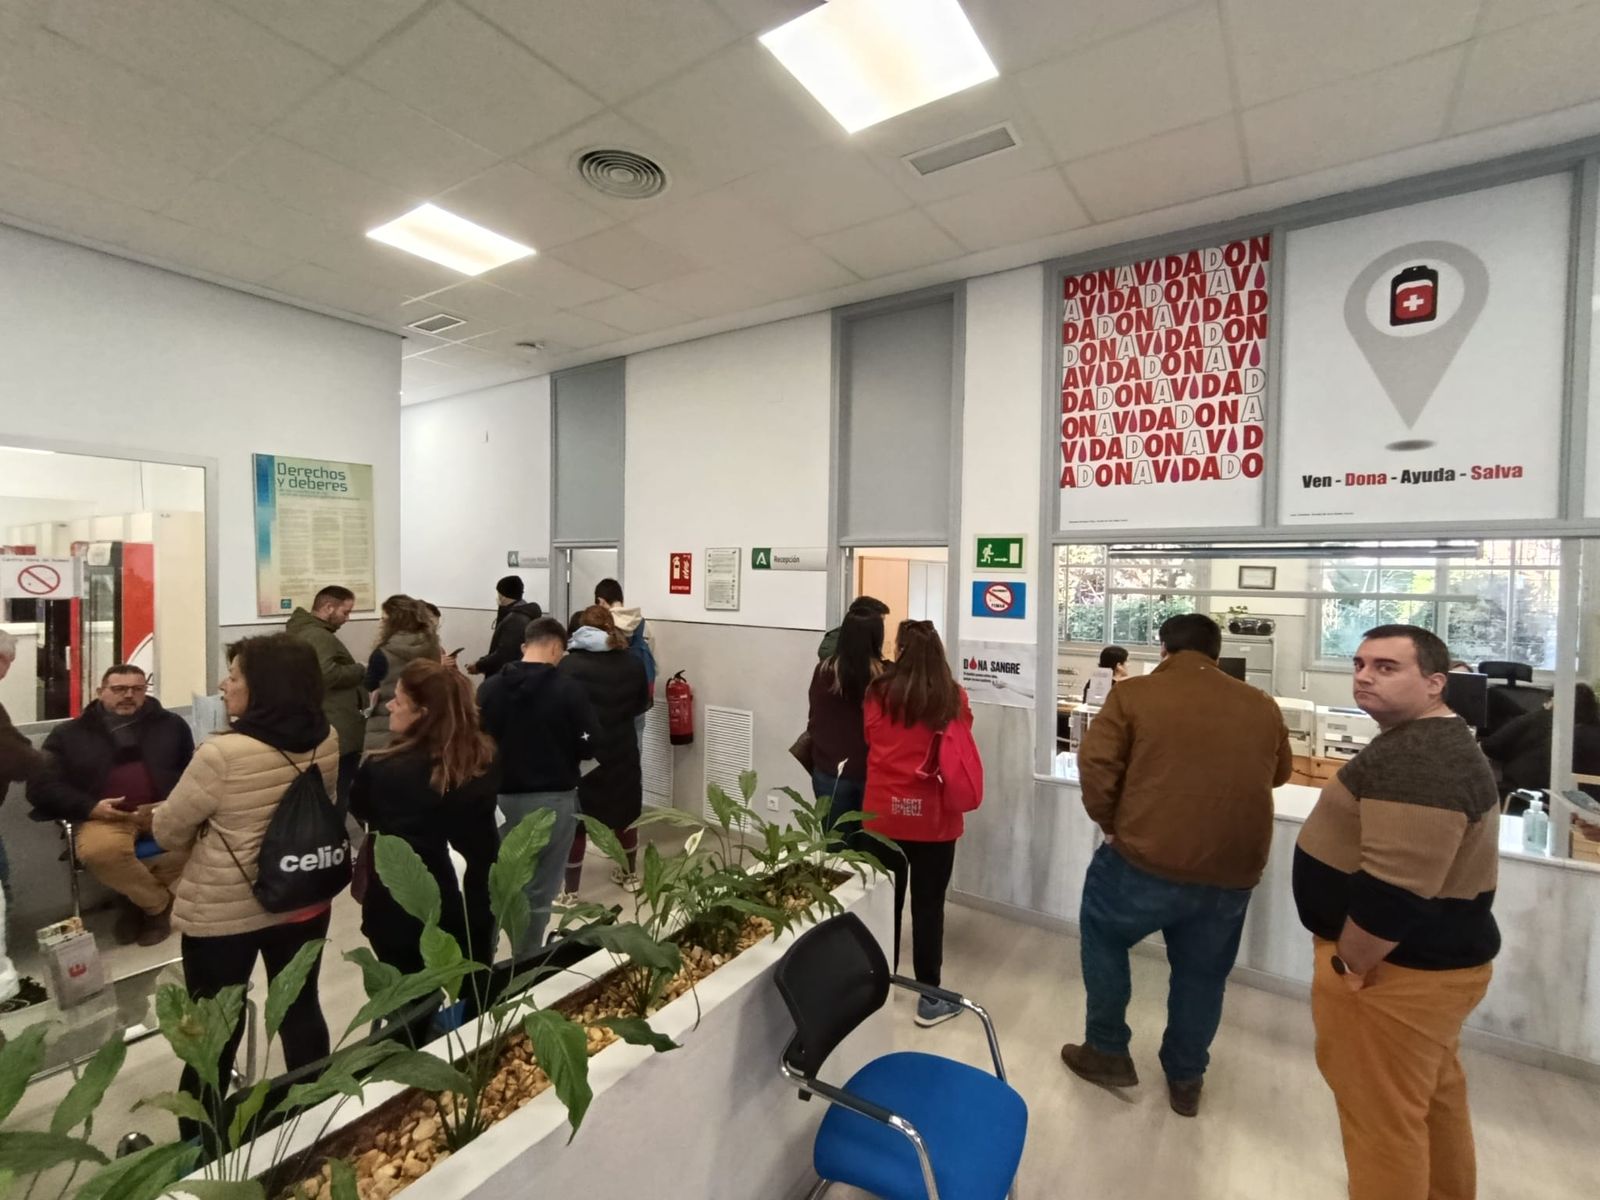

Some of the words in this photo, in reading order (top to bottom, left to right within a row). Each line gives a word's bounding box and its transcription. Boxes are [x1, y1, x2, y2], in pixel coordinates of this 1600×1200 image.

[277, 462, 346, 481] Derechos
[1302, 474, 1332, 488] Ven
[1345, 472, 1387, 486] Dona
[1400, 467, 1456, 485] Ayuda
[1471, 464, 1523, 481] Salva
[288, 476, 348, 492] deberes
[774, 555, 800, 565] Recepción
[990, 661, 1021, 674] SANGRE
